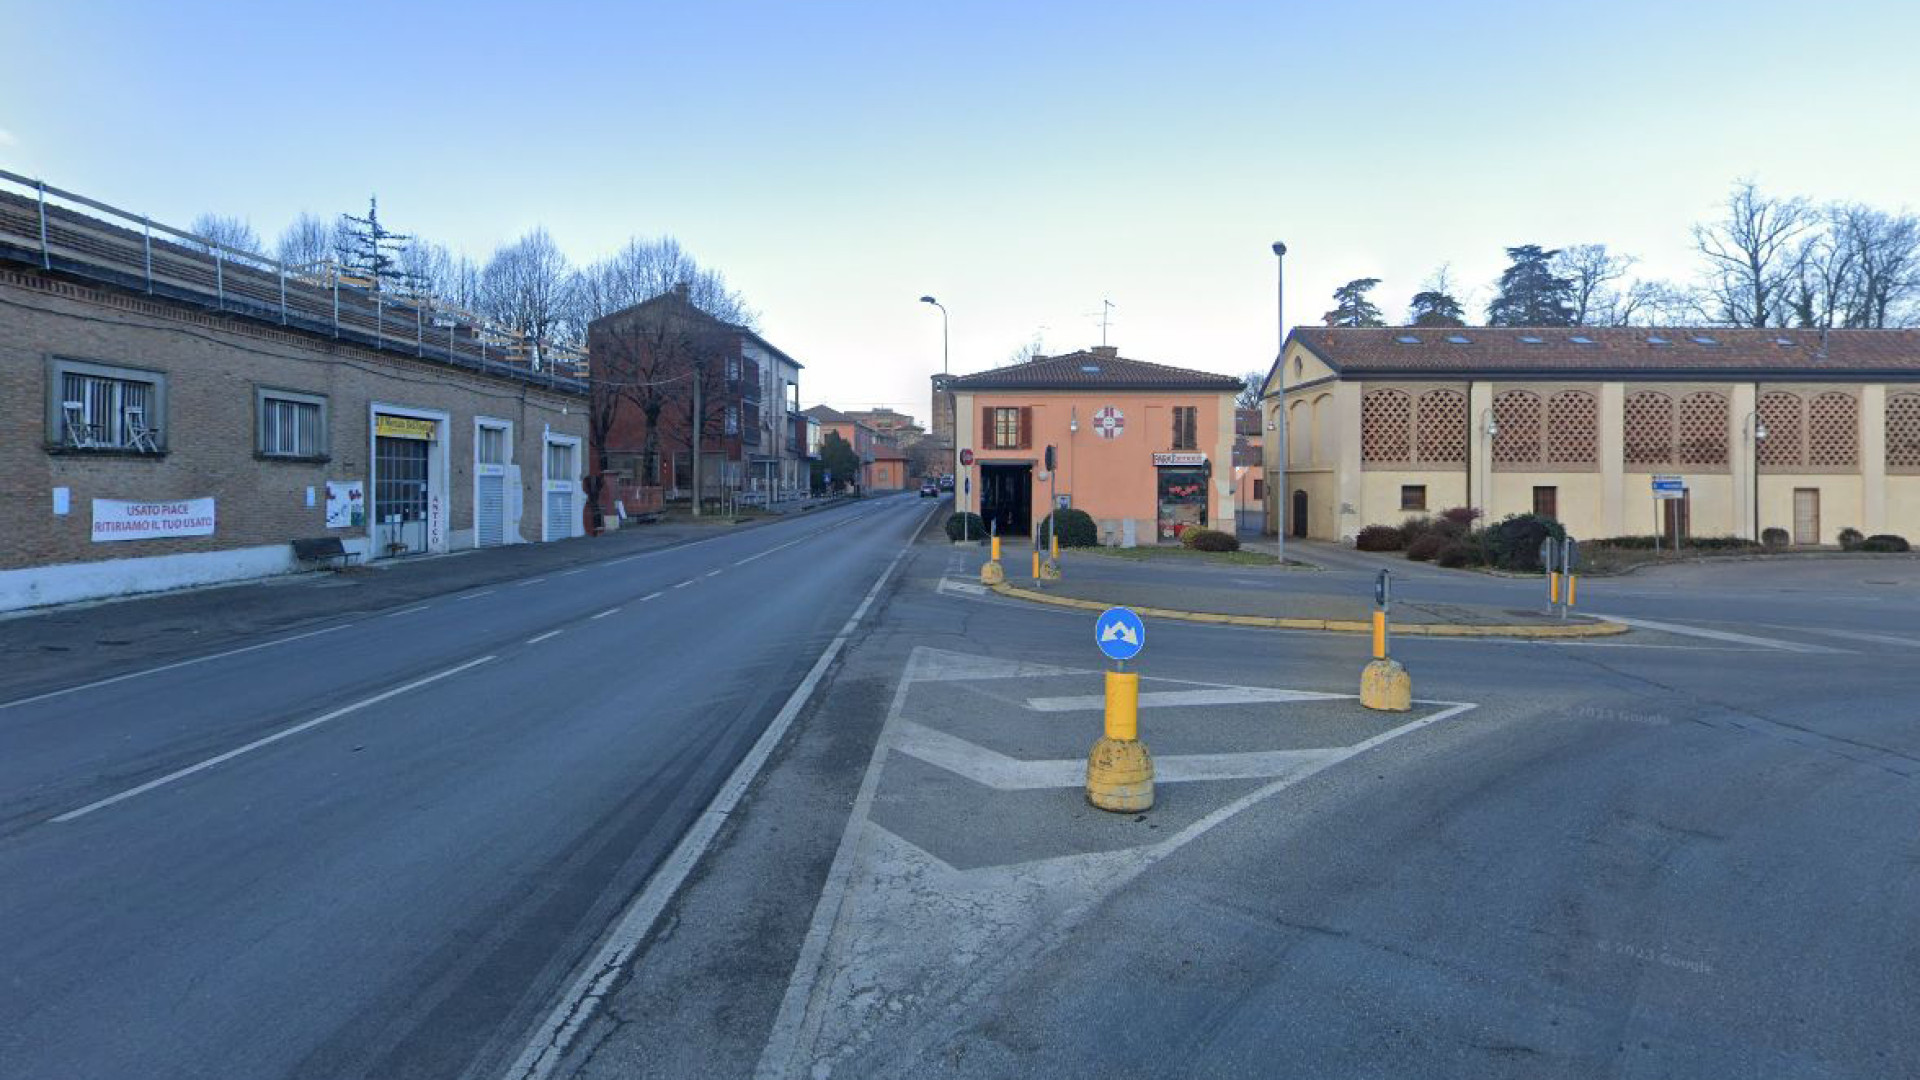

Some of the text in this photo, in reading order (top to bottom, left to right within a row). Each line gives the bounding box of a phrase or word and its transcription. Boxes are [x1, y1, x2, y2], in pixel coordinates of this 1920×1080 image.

[127, 504, 189, 516] USATO PIACE
[94, 516, 212, 533] RITIRIAMO IL TUO USATO
